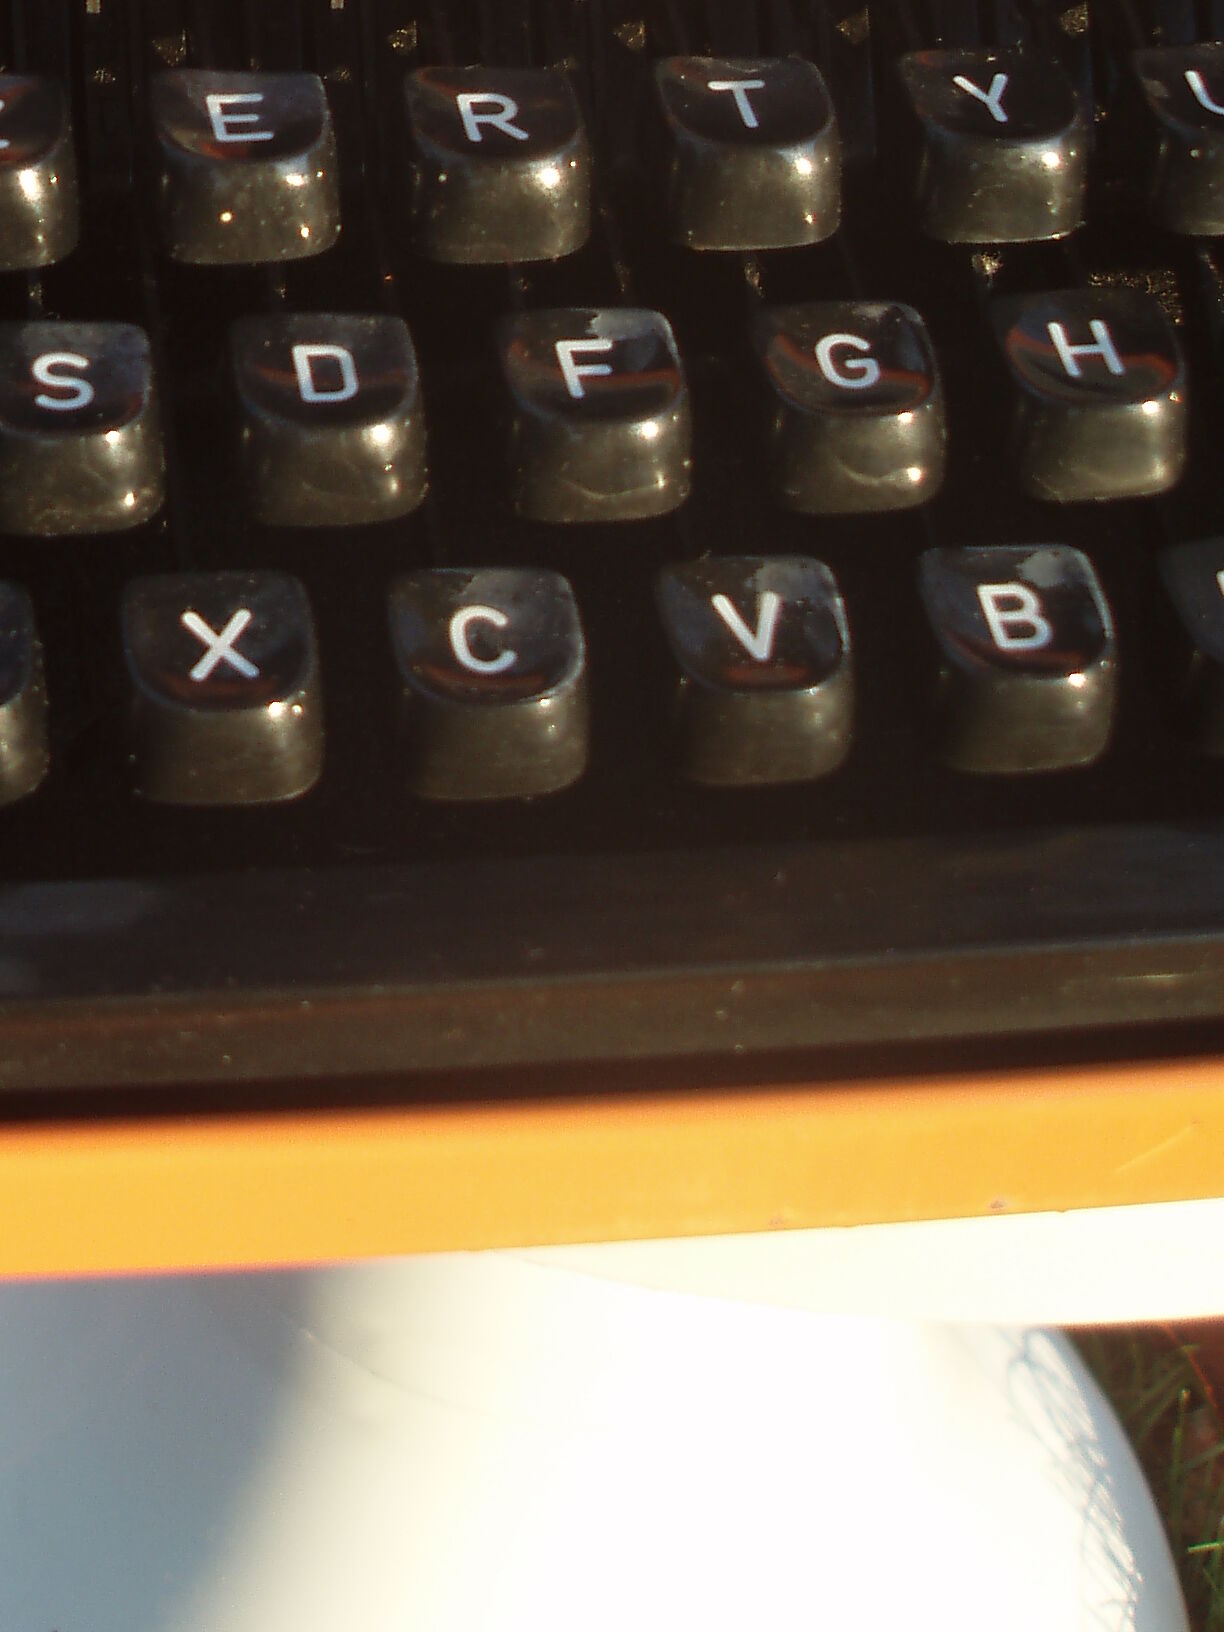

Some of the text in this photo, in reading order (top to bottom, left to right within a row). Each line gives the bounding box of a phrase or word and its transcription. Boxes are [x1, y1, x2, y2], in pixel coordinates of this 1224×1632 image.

[205, 93, 272, 142] E
[456, 93, 528, 142] R
[707, 80, 765, 128] T
[953, 73, 1008, 122] Y
[292, 344, 358, 401] D
[555, 337, 613, 397] F
[815, 333, 880, 388] G
[1047, 319, 1123, 376] H
[32, 352, 92, 409] S
[182, 609, 256, 680] X
[449, 605, 516, 673] C
[712, 591, 780, 660] V
[978, 583, 1049, 649] B
